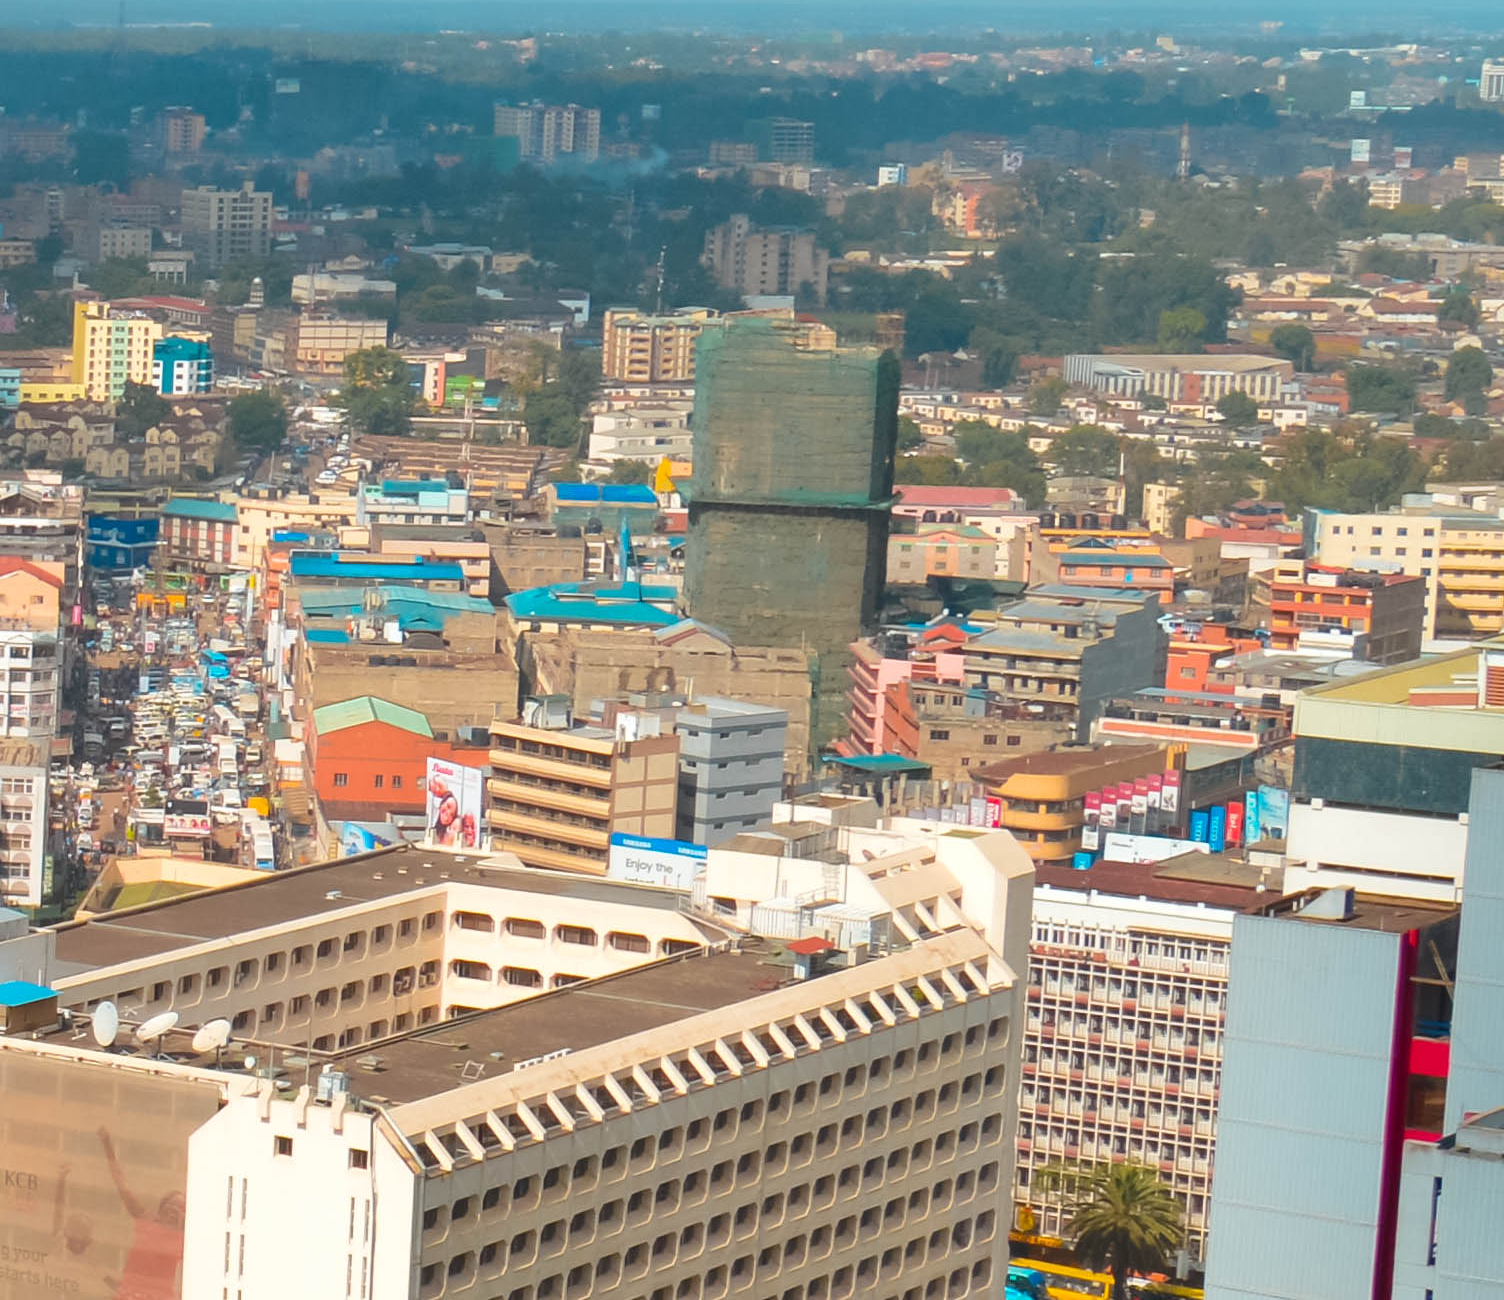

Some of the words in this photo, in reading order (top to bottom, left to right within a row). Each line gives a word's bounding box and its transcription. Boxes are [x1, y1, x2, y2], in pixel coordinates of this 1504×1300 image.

[625, 858, 653, 873] Enjoy
[655, 863, 674, 874] the
[5, 1169, 38, 1190] KCB
[12, 1247, 48, 1263] your
[45, 1272, 81, 1293] here
